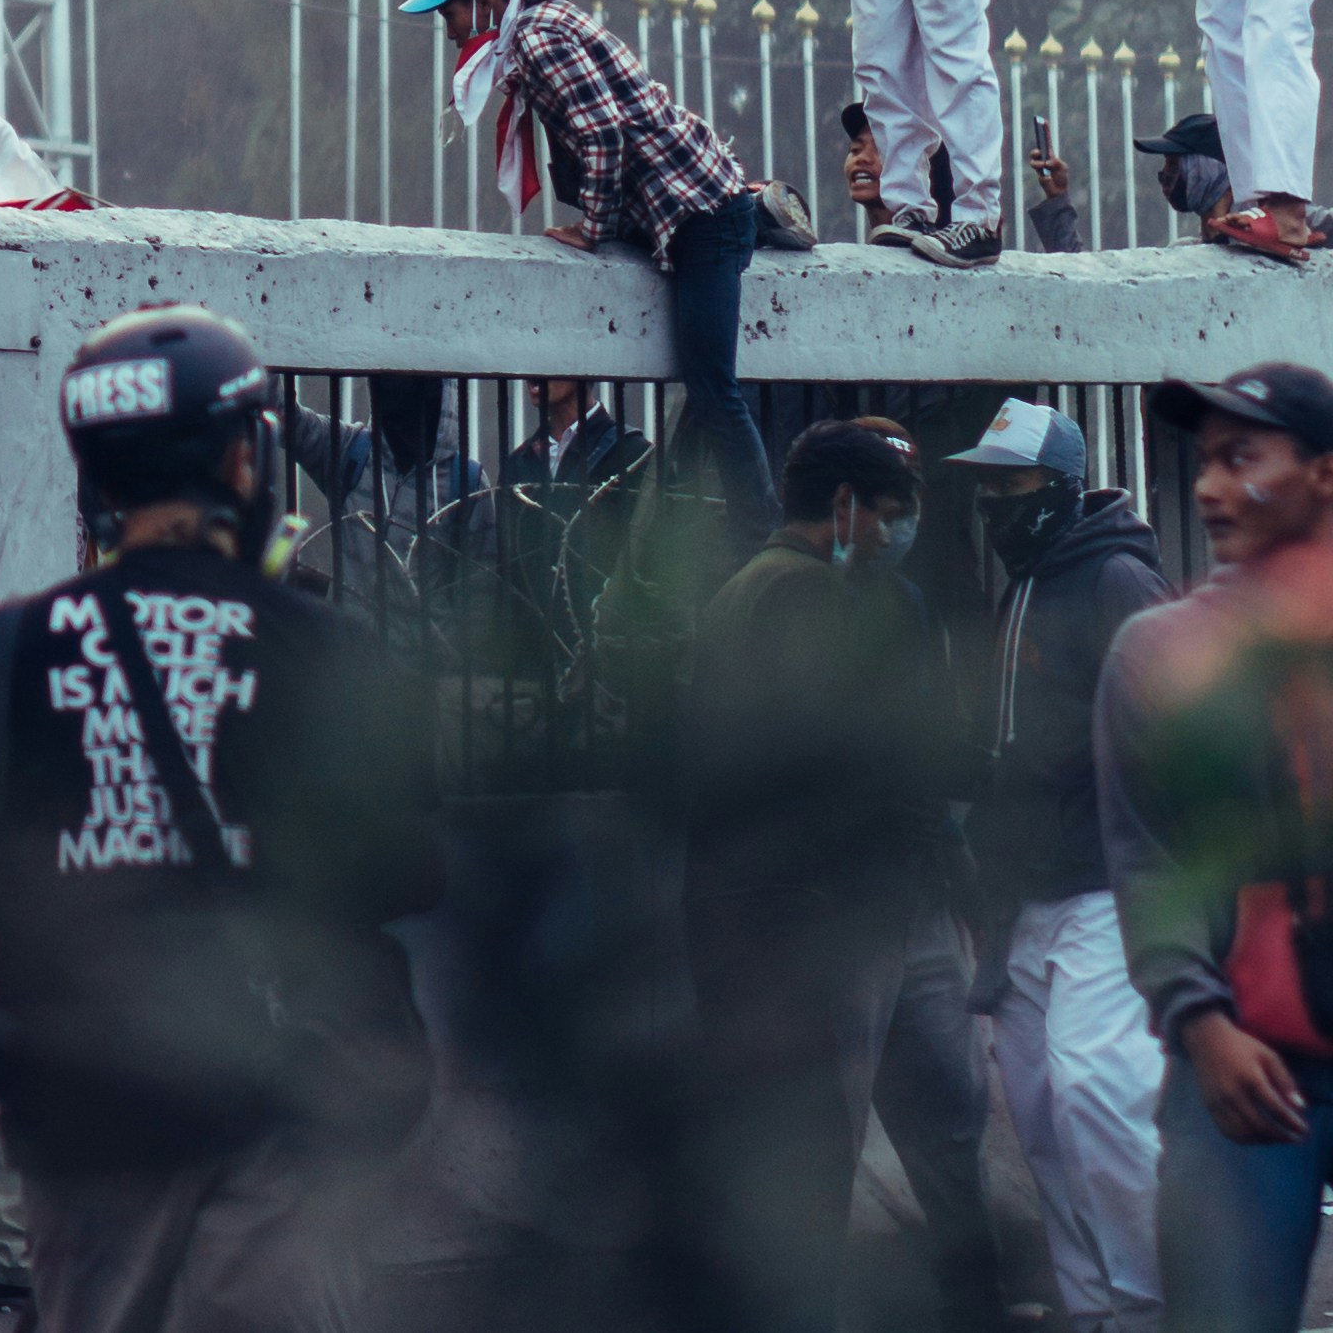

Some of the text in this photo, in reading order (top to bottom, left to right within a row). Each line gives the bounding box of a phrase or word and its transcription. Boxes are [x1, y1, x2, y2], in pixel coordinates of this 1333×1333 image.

[67, 363, 164, 422] PRESS
[81, 629, 223, 667] CCLE
[48, 665, 95, 709] IS
[85, 742, 211, 784] THN
[58, 824, 251, 871] MACHE
